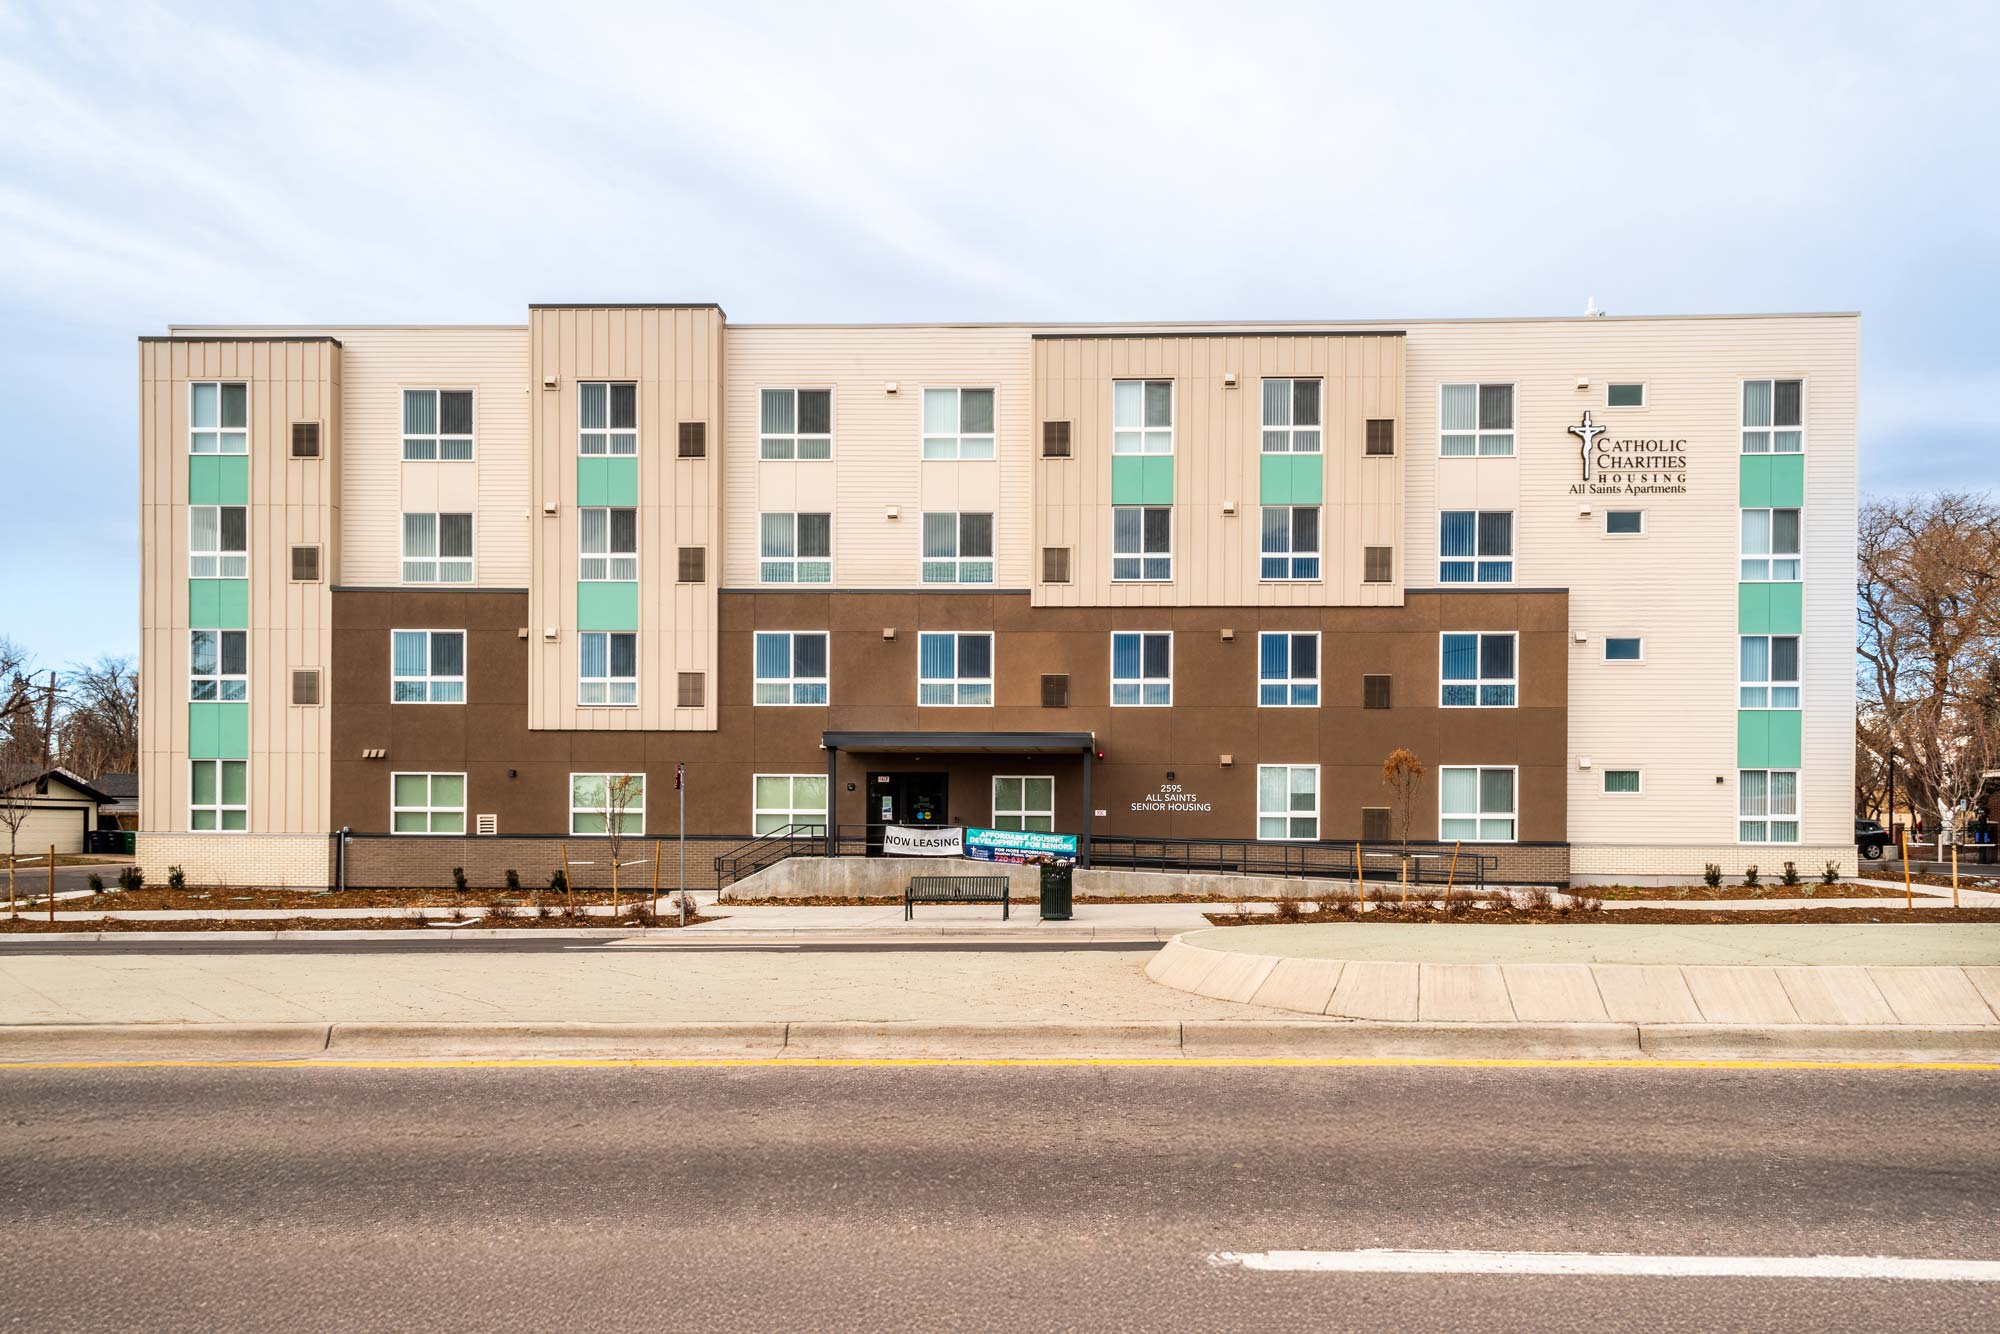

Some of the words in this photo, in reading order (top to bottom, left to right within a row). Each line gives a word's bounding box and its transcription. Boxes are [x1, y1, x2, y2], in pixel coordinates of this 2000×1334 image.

[1597, 438, 1687, 452] CATHOLIC
[1597, 454, 1687, 469] CHARITIES
[1598, 474, 1686, 483] HOUSING
[1569, 484, 1585, 494] All
[1589, 484, 1621, 494] Saints
[1625, 484, 1687, 496] Apartments
[1160, 784, 1182, 793] 2595
[1145, 794, 1163, 802] ALL
[1164, 794, 1197, 802] SAINTS
[1131, 803, 1166, 811] SENIOR
[1168, 803, 1211, 812] HOUSING
[885, 835, 911, 846] NOW
[913, 837, 960, 848] LEASING
[980, 831, 1030, 841] AFFORDABLE
[1030, 836, 1064, 844] HOUSING
[969, 837, 1024, 847] DEVELOPMENT
[1025, 841, 1041, 849] FOR
[1042, 842, 1074, 851] SENIORS
